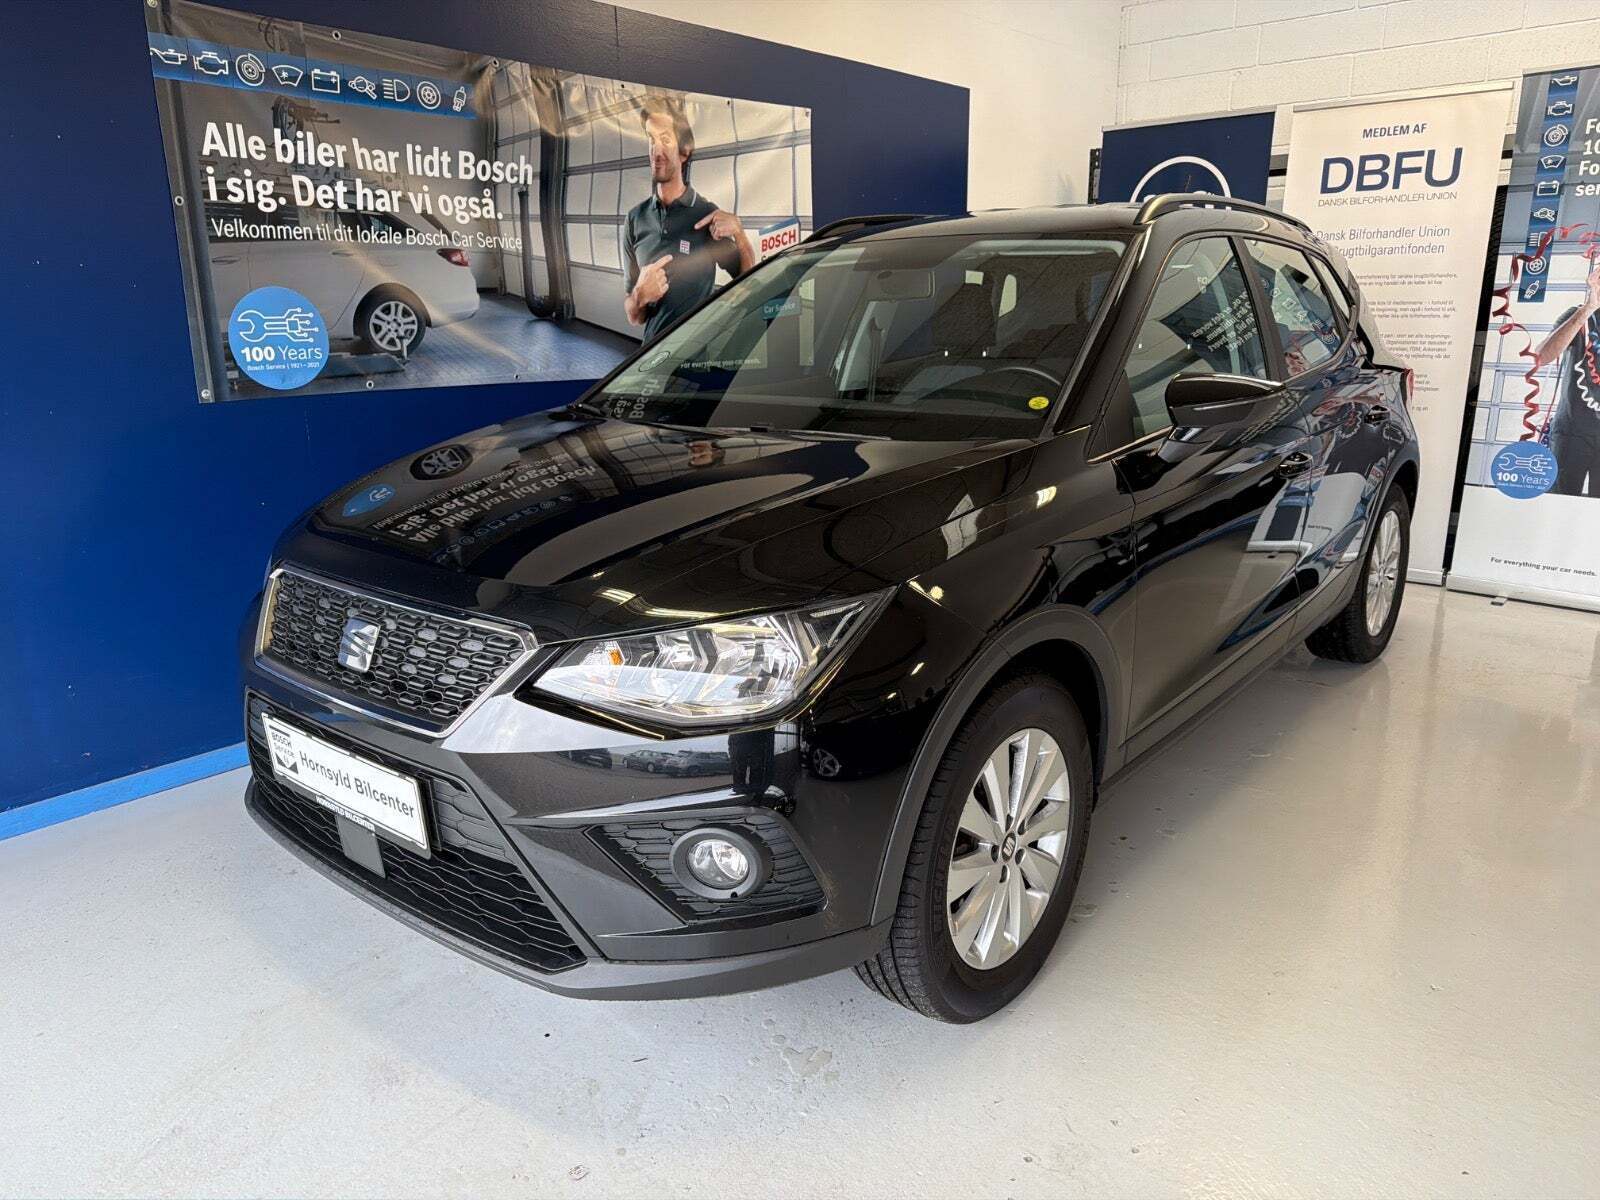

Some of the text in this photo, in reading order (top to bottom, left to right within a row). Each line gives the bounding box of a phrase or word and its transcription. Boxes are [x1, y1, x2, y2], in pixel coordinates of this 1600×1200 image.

[1362, 123, 1427, 139] MEDLEM AF
[202, 122, 533, 184] Alle biler har lidt Bosch
[1320, 147, 1463, 195] DBFU
[206, 167, 503, 224] i sig. Det har vi også.
[1318, 192, 1457, 207] DANSK BILFORHANDLER UNION
[211, 217, 522, 249] Velkommen til dit lokale Bosch Car Service
[761, 229, 796, 252] BOSCH
[1315, 226, 1450, 241] Dansk Bilforhandler Union
[241, 345, 323, 362] 100 Years
[1496, 471, 1518, 482] 100
[1521, 473, 1550, 486] Years
[1490, 556, 1502, 564] For
[1503, 560, 1541, 570] everything
[271, 731, 293, 749] BOSCH
[299, 750, 415, 819] Hornsyld Bilcenter
